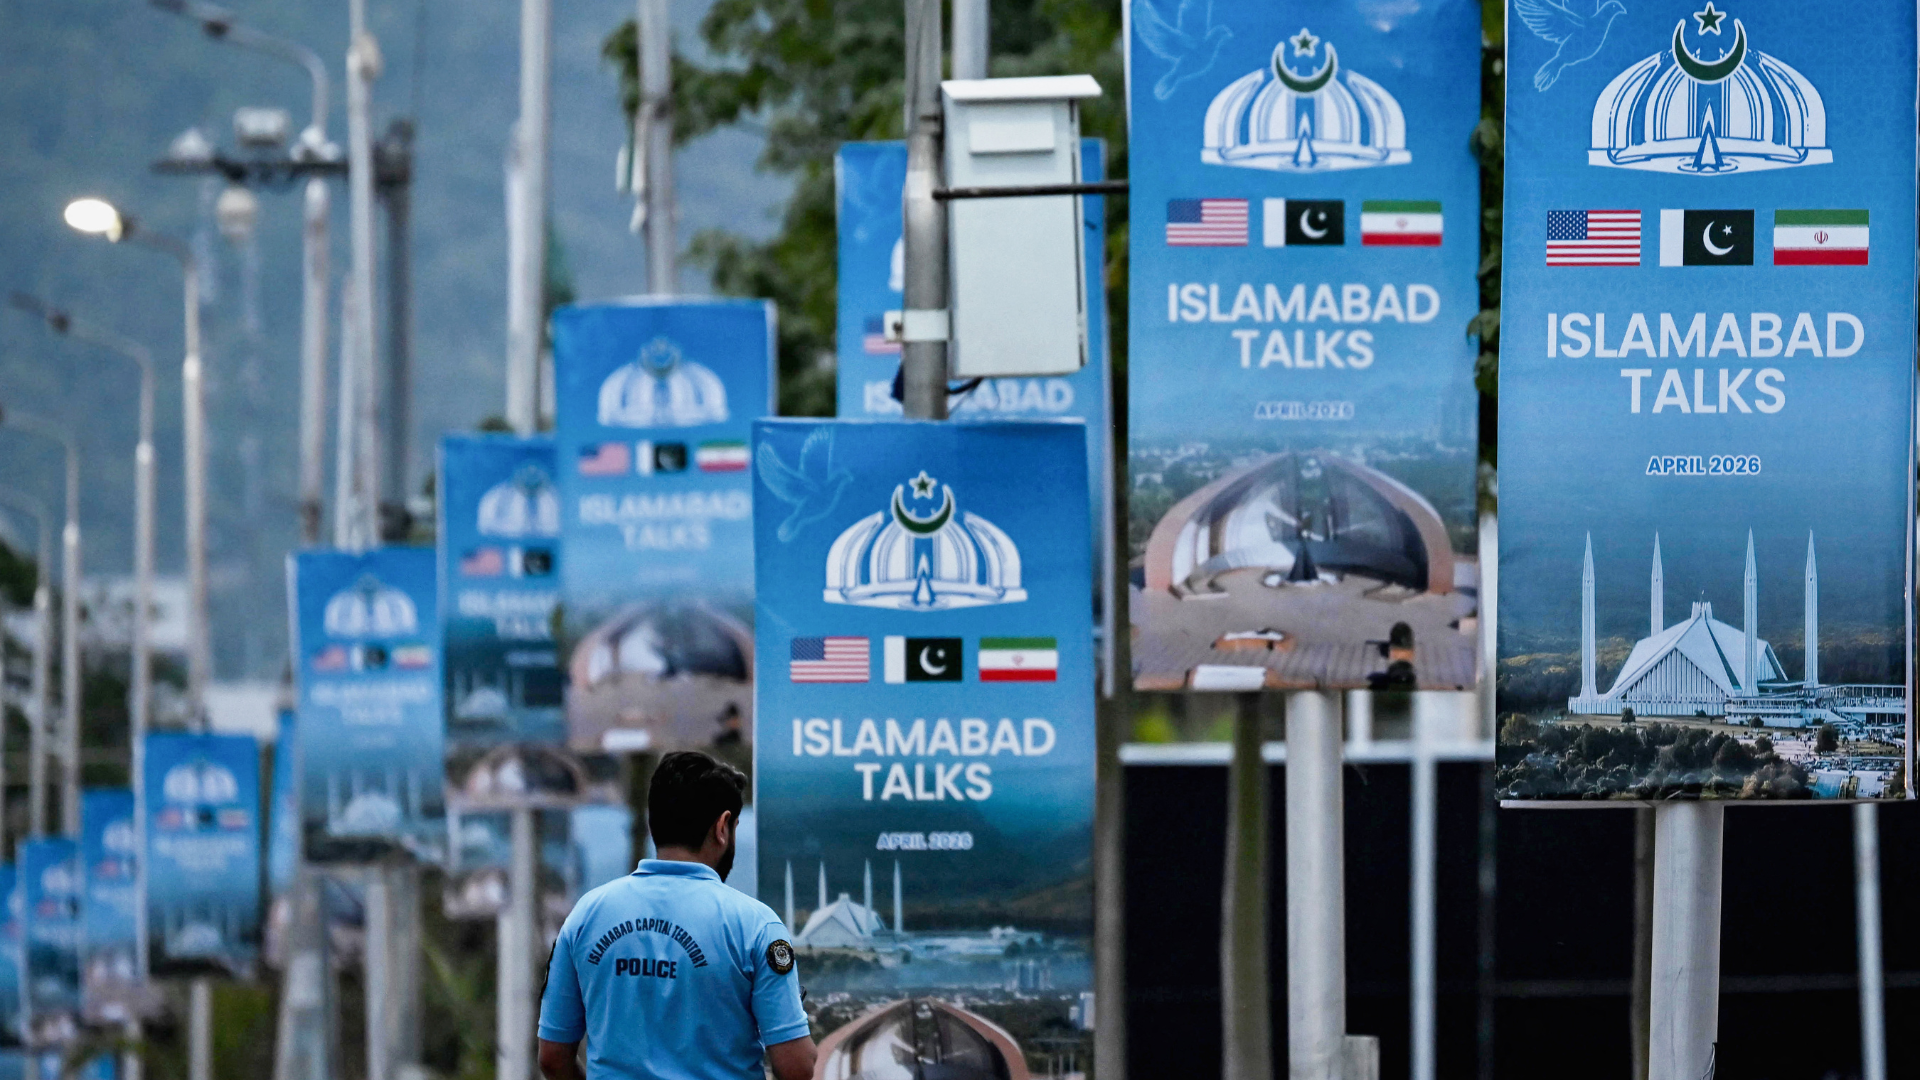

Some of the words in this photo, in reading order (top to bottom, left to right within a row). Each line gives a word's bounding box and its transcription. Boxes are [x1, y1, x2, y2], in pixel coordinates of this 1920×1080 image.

[1168, 283, 1440, 323] ISLAMABAD
[1231, 329, 1375, 369] TALKS
[1547, 312, 1865, 358] ISLAMABAD
[1620, 368, 1786, 414] TALKS
[1646, 455, 1705, 475] APRIL
[1709, 454, 1761, 475] 2026
[792, 718, 1057, 756] ISLAMABAD
[854, 762, 993, 801] TALKS
[876, 832, 927, 850] APRIL
[928, 831, 974, 850] 2026
[588, 920, 634, 966] ISLAMABAD
[636, 918, 673, 936] CAPITAL
[671, 924, 709, 969] TERRITORY
[616, 958, 677, 979] POLICE
